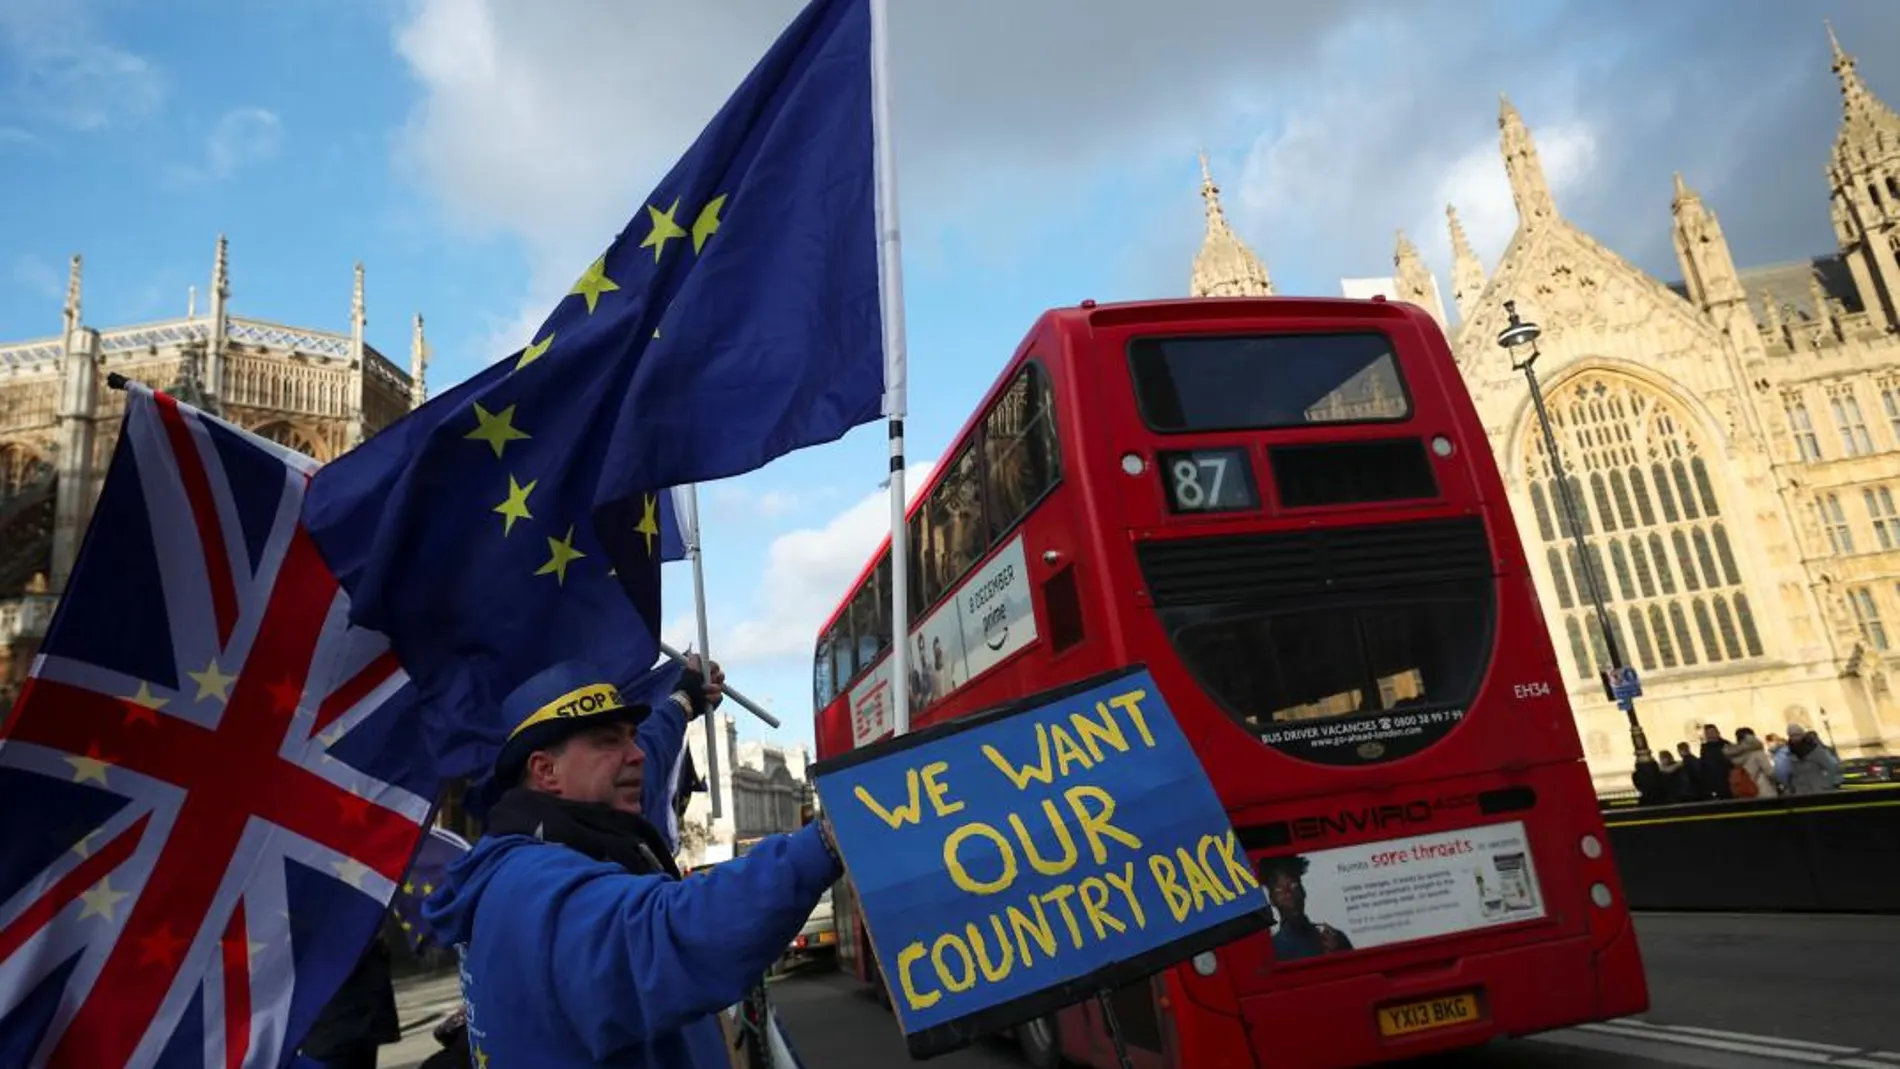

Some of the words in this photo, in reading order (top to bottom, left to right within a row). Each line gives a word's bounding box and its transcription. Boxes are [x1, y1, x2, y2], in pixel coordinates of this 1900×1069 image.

[1173, 457, 1227, 507] 87
[975, 564, 1016, 609] DECEMBER
[982, 604, 1006, 634] prime
[556, 692, 607, 717] STOP
[1514, 681, 1551, 699] EH34
[1261, 731, 1283, 744] BUS
[1283, 726, 1320, 742] DRIVER
[1320, 719, 1378, 737] VACANCIES
[1394, 714, 1417, 728] 0800
[854, 760, 965, 830] WE
[980, 689, 1157, 791] WANT
[942, 784, 1143, 894] OUR
[1292, 800, 1432, 842] ENVIRO
[1371, 849, 1409, 869] sore
[1410, 838, 1474, 864] throats
[896, 861, 1146, 1011] COUNTRY
[1148, 828, 1260, 923] BACK
[1389, 1004, 1429, 1029] YX13
[1433, 998, 1468, 1021] BKG
